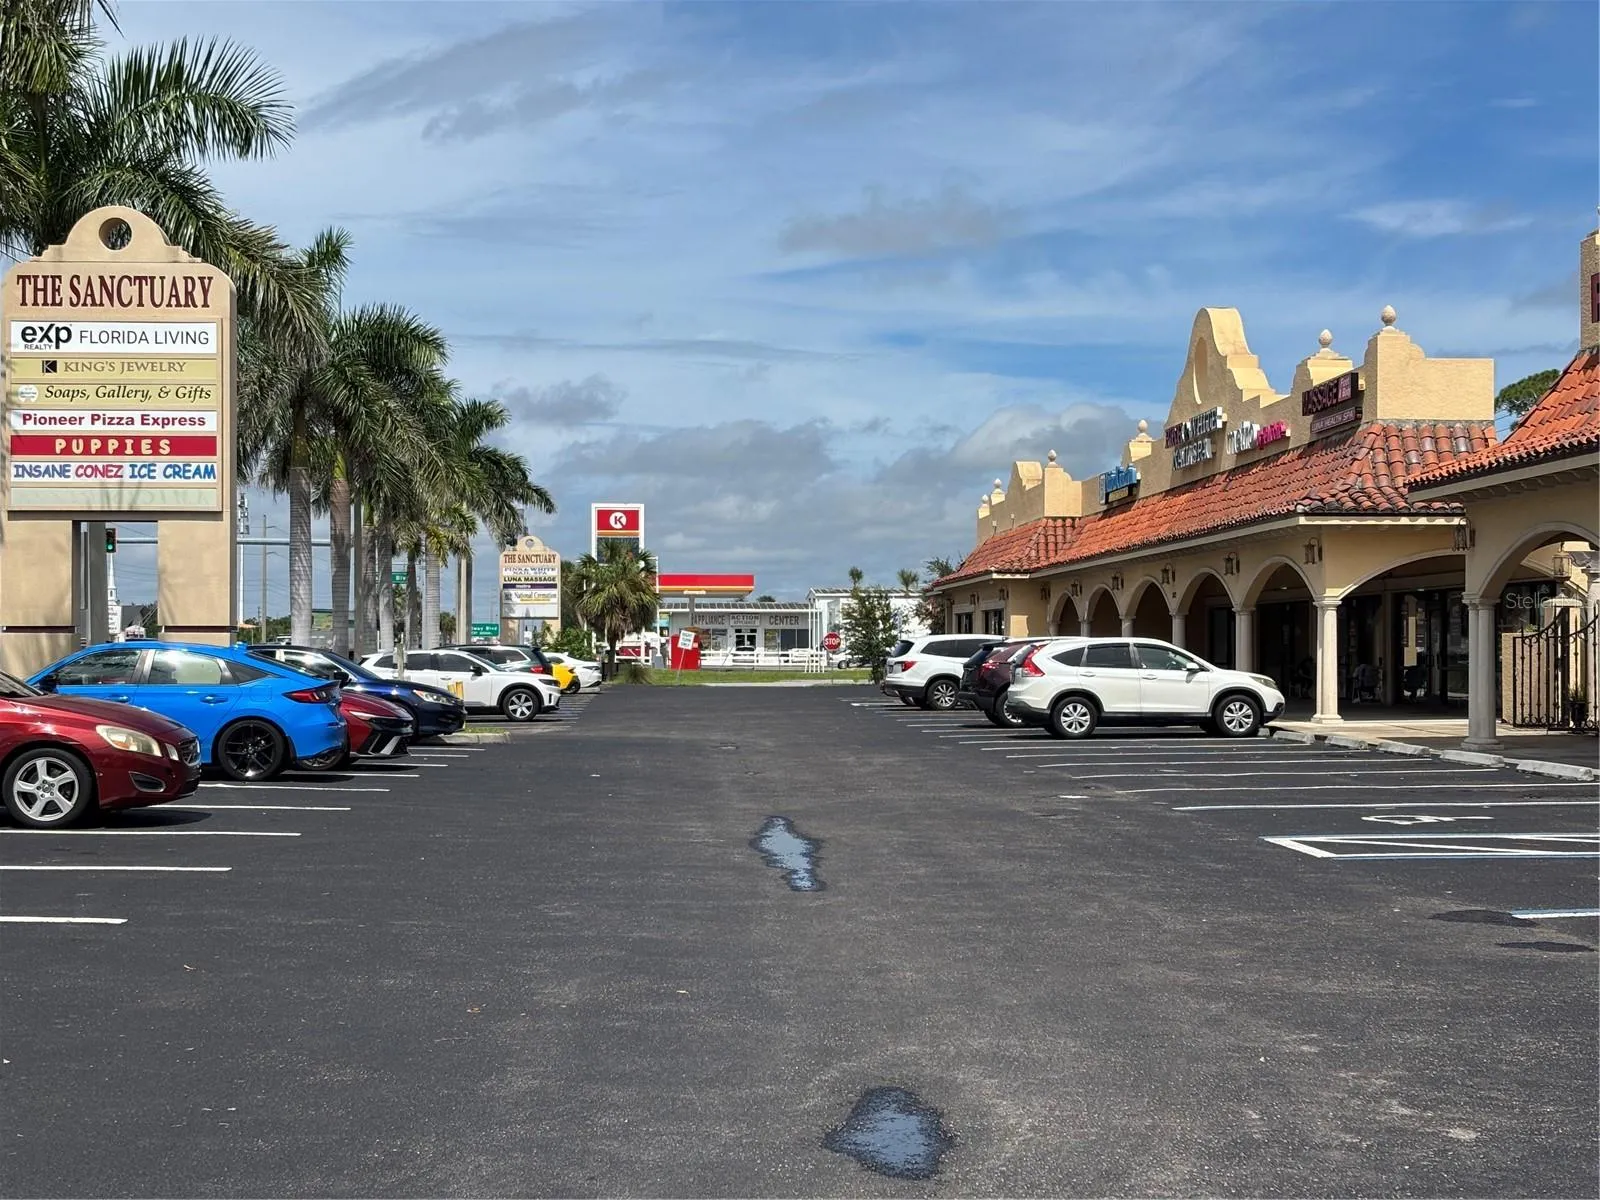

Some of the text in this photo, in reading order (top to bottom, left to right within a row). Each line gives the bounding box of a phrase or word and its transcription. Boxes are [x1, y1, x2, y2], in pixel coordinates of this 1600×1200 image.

[17, 274, 213, 309] THE SANCTUARY
[79, 330, 149, 345] FLORIDA
[154, 330, 209, 345] LIVING
[64, 361, 187, 373] KING'S JEWELRY
[45, 385, 90, 402] Soaps,
[95, 386, 152, 402] Gallery,
[158, 387, 171, 400] &
[175, 386, 212, 400] Gifts
[22, 413, 206, 428] Pioneer Pizza Express
[55, 438, 171, 455] PUPPIES
[14, 463, 216, 480] INSANE CONEZ ICE CREAM
[614, 515, 624, 525] K
[504, 554, 557, 564] THE SANCTUARY
[694, 615, 726, 626] APPLIANCE
[769, 615, 800, 626] CENTER
[824, 637, 840, 646] STOP
